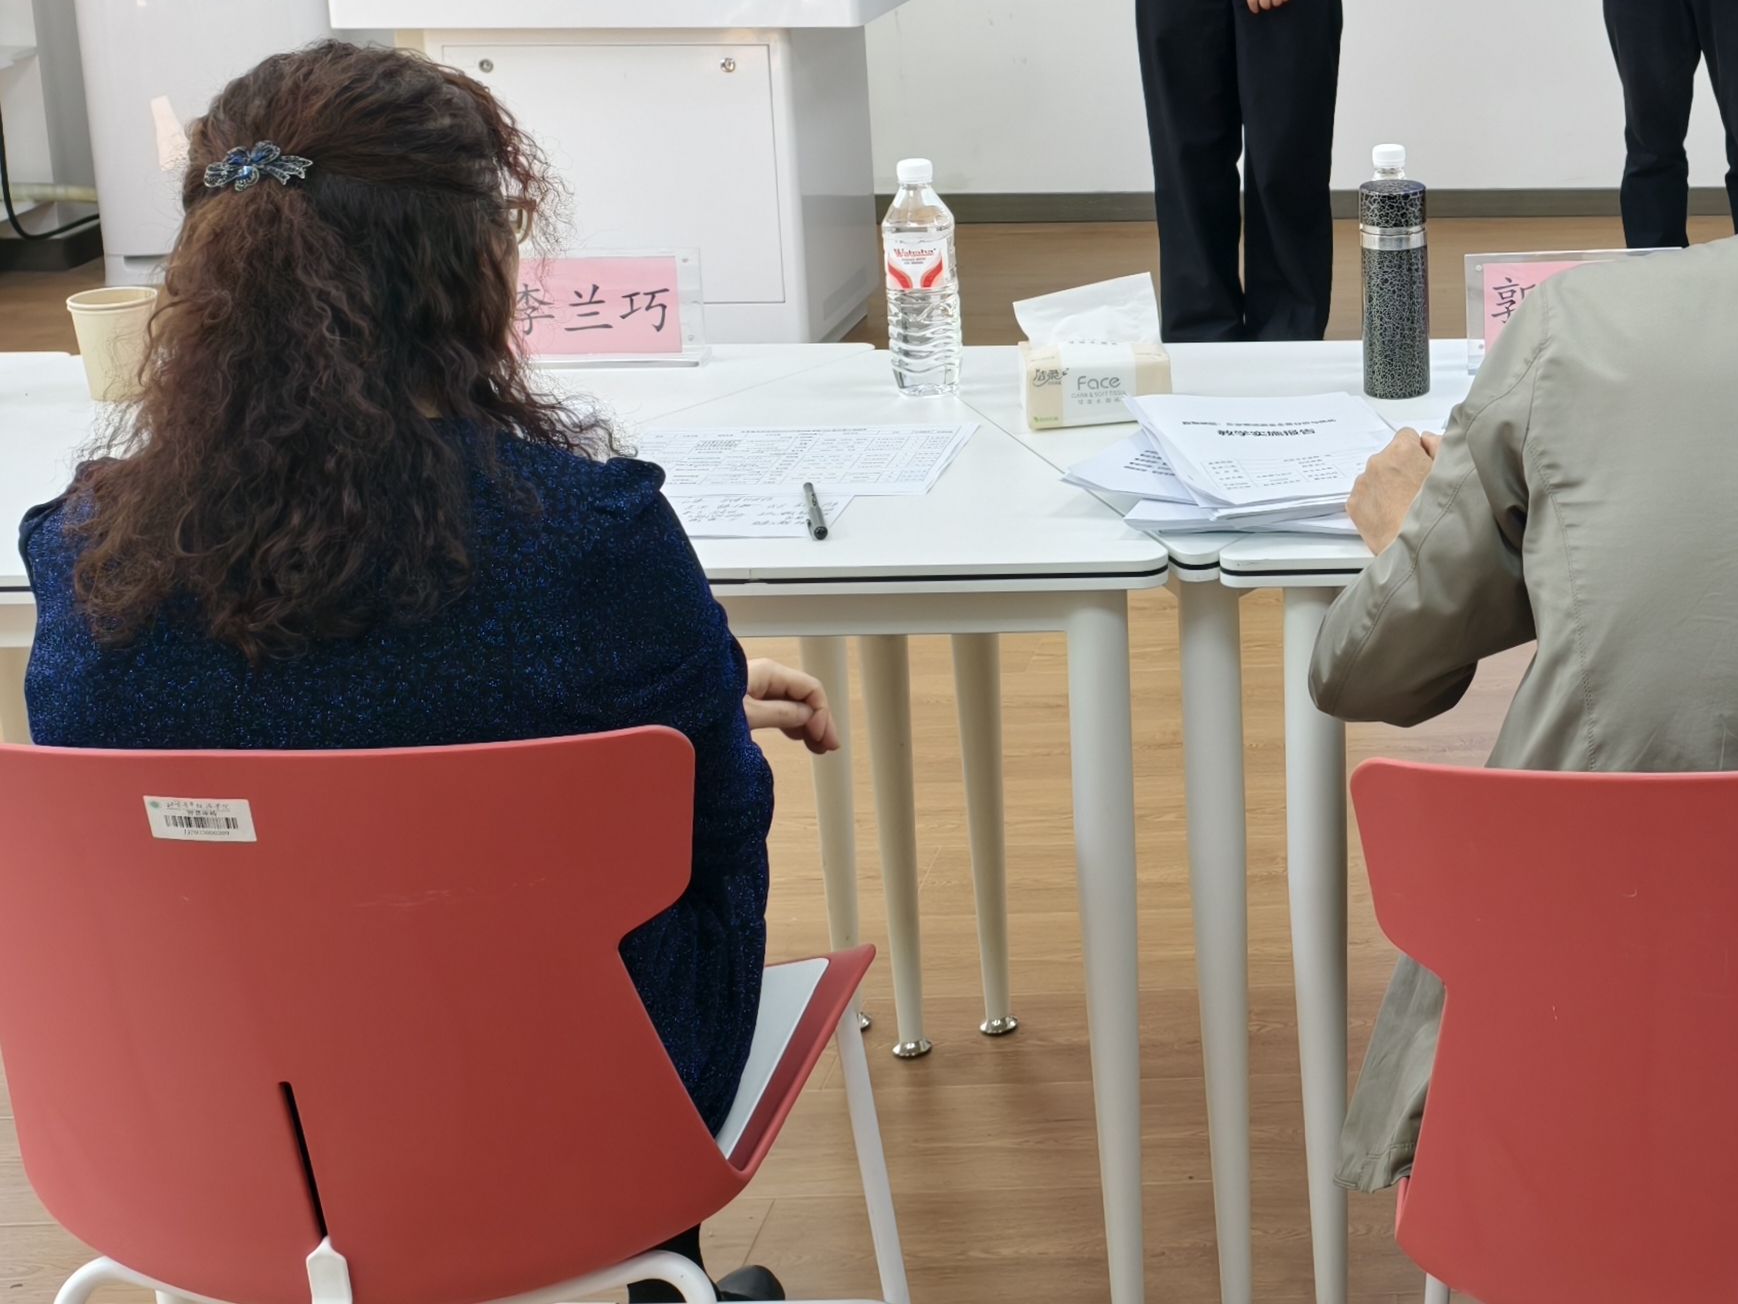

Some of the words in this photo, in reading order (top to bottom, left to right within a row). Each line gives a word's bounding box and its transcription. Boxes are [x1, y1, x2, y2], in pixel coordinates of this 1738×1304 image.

[516, 282, 671, 336] 李兰巧
[1077, 375, 1121, 390] Face
